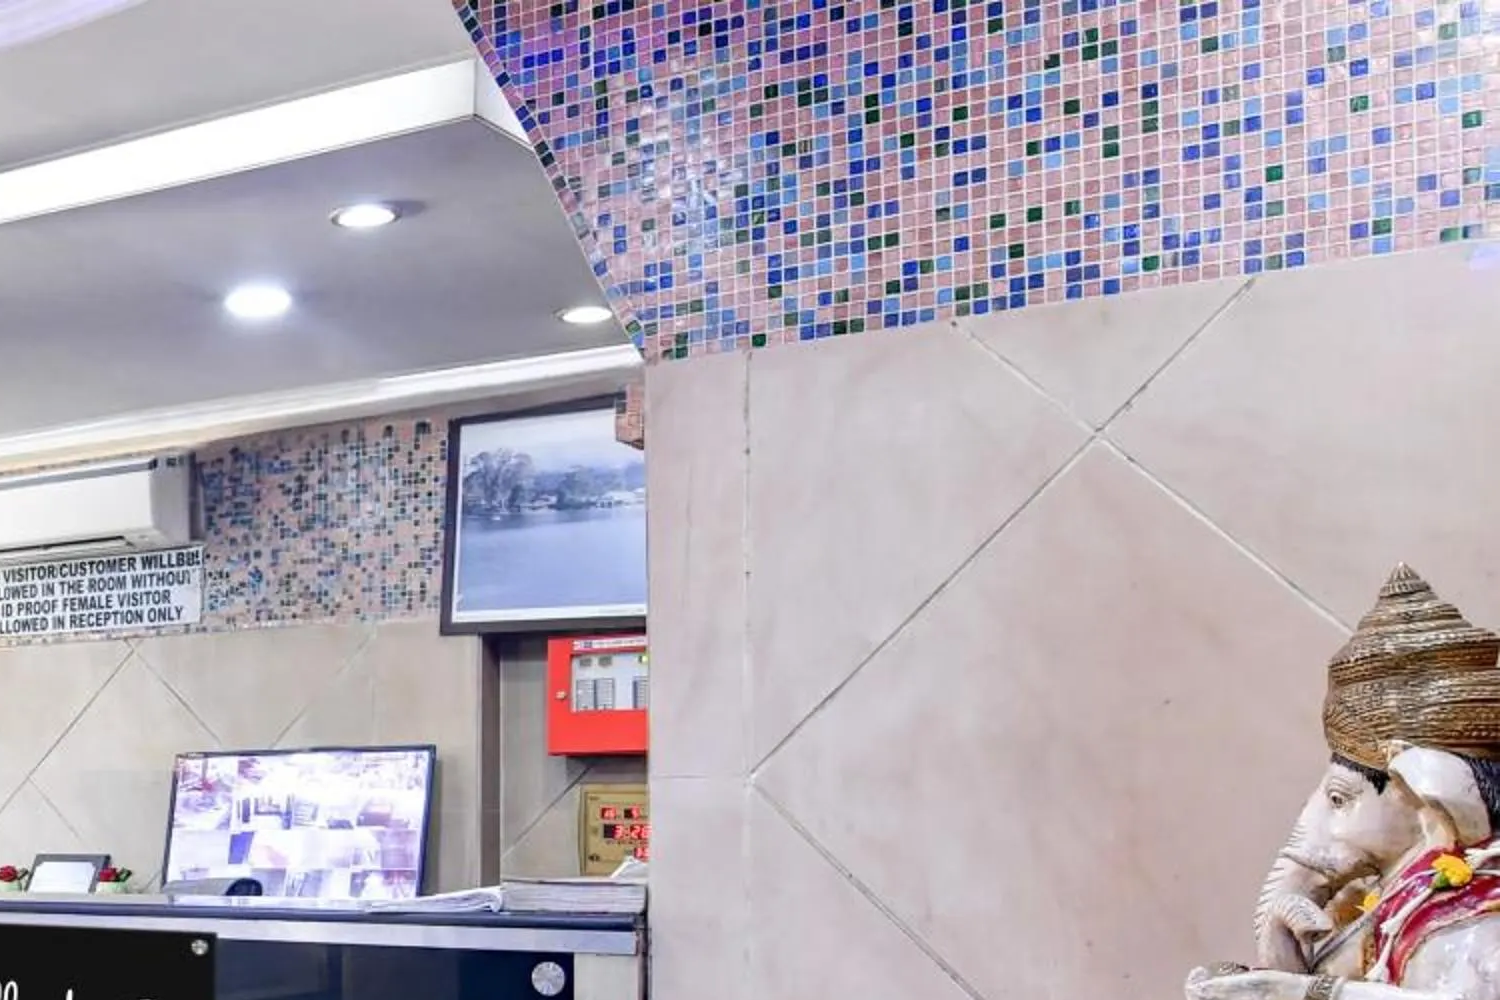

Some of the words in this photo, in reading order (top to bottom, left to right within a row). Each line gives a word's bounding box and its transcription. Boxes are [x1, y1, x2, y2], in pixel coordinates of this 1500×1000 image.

[3, 564, 56, 583] VISITOR
[59, 557, 137, 578] CUSTOMER
[41, 582, 55, 597] IN
[58, 579, 85, 595] THE
[88, 575, 127, 593] ROOM
[1, 603, 13, 618] ID
[17, 599, 58, 616] PROOF
[63, 593, 113, 612] FEMALE
[118, 589, 171, 608] VISITOR
[52, 615, 65, 630] IN
[69, 609, 143, 629] RECEPTION
[147, 605, 184, 623] ONLY
